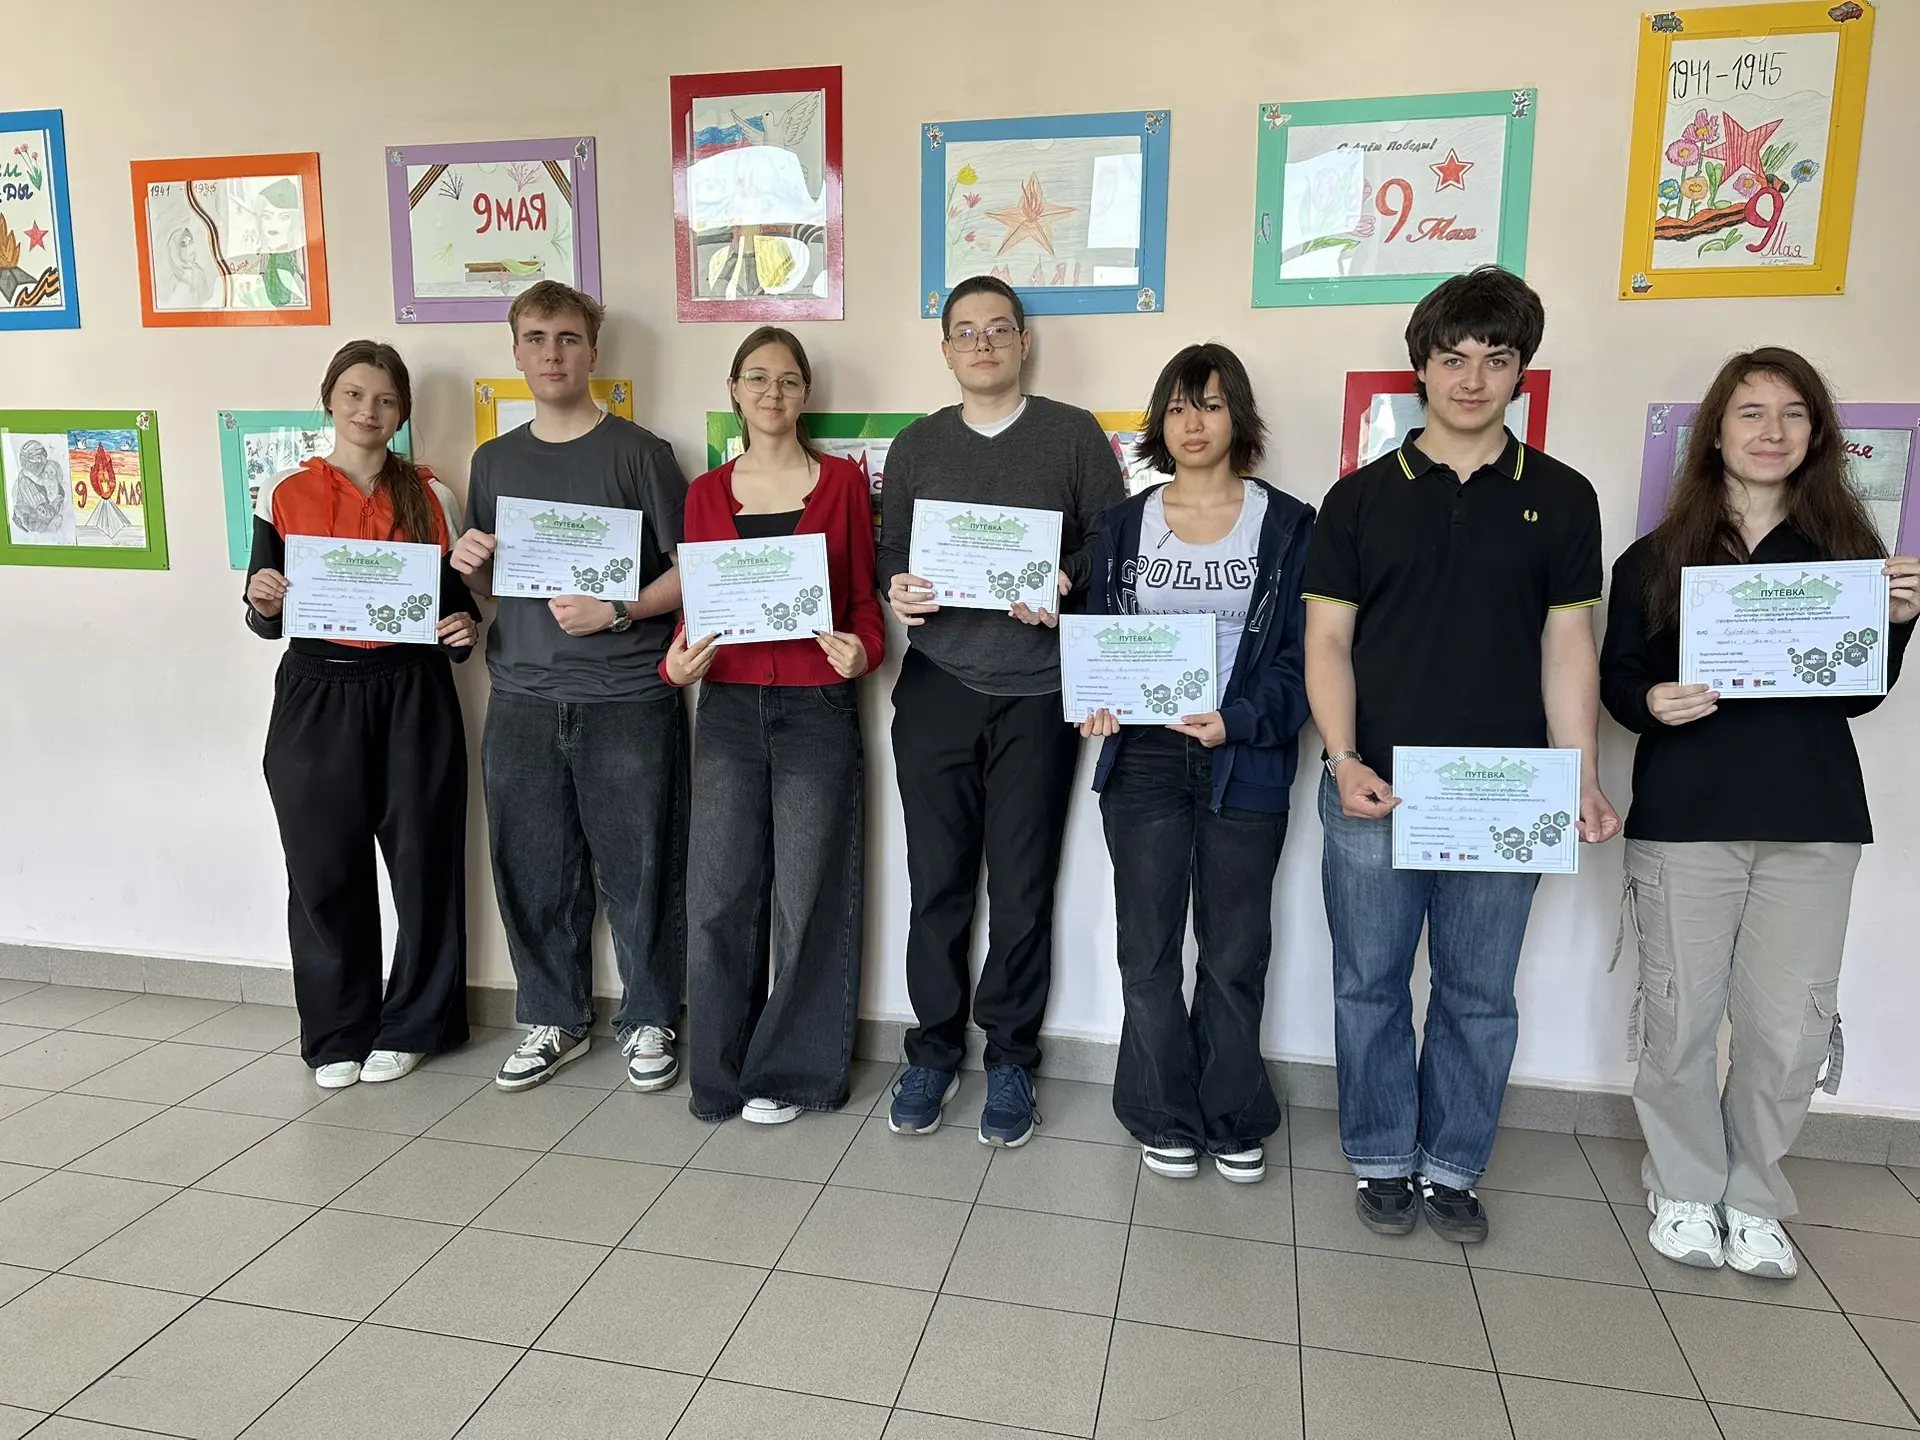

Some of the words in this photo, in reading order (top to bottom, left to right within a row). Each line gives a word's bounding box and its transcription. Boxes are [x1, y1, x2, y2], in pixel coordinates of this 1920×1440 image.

[1669, 60, 1711, 99] 1941
[1732, 52, 1788, 91] 1945
[149, 185, 170, 197] 1941
[1375, 178, 1414, 243] 9
[1405, 215, 1477, 243] Мая
[473, 192, 492, 234] 9
[1744, 187, 1785, 252] 9
[1761, 220, 1802, 258] Мая
[75, 480, 87, 509] 9
